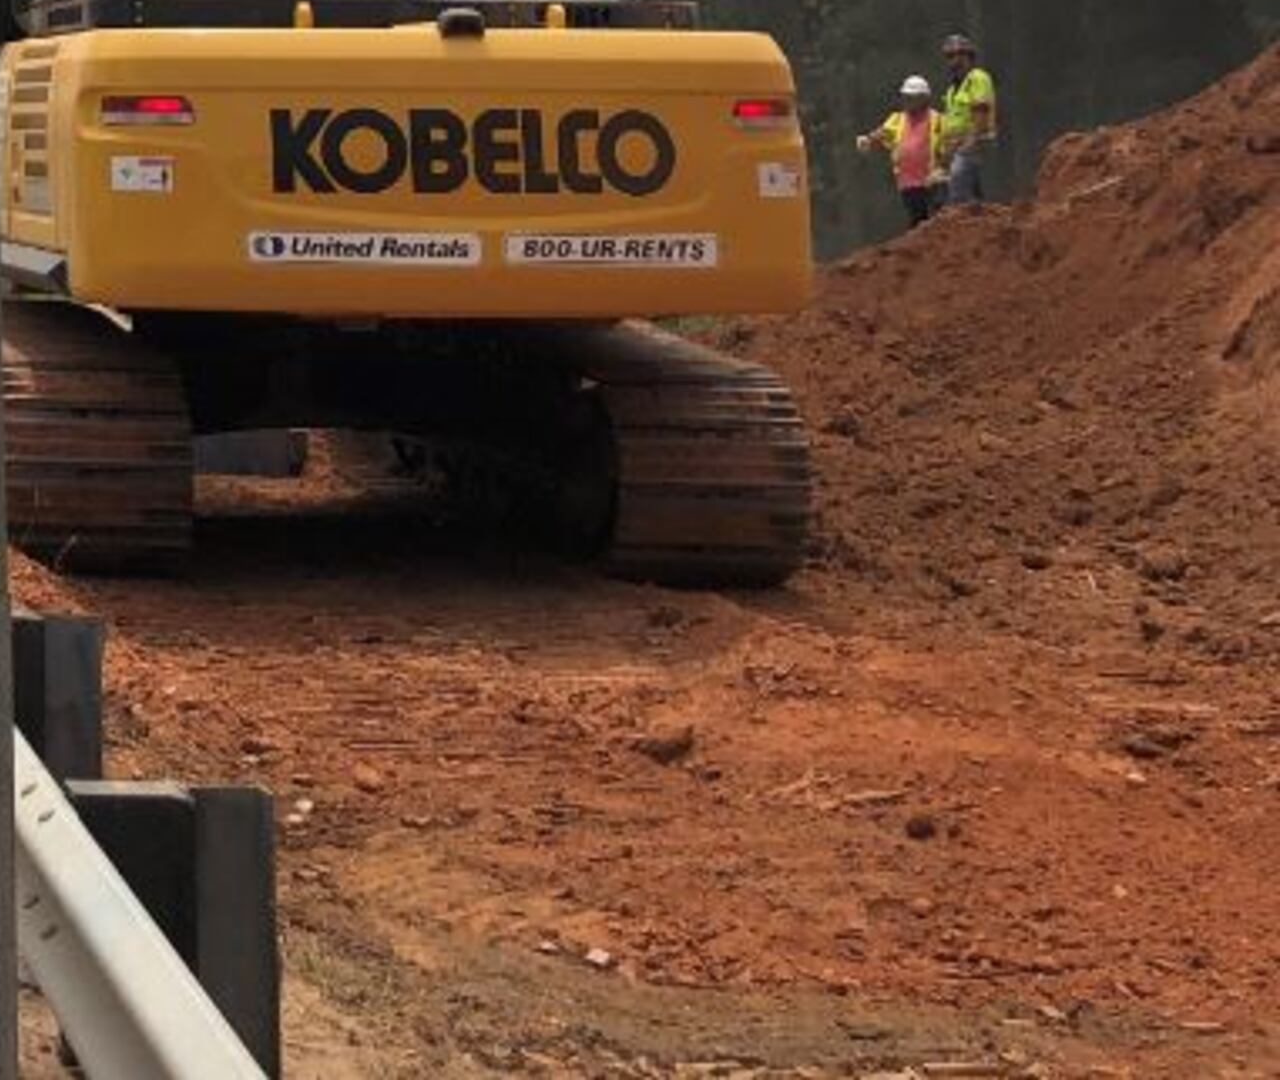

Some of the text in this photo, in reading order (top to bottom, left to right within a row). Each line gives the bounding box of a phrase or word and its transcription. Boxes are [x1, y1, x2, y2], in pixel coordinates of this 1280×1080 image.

[269, 108, 676, 196] KOBELCO
[291, 236, 470, 259] United Rentals
[522, 238, 706, 261] 800-UR-RENTS
